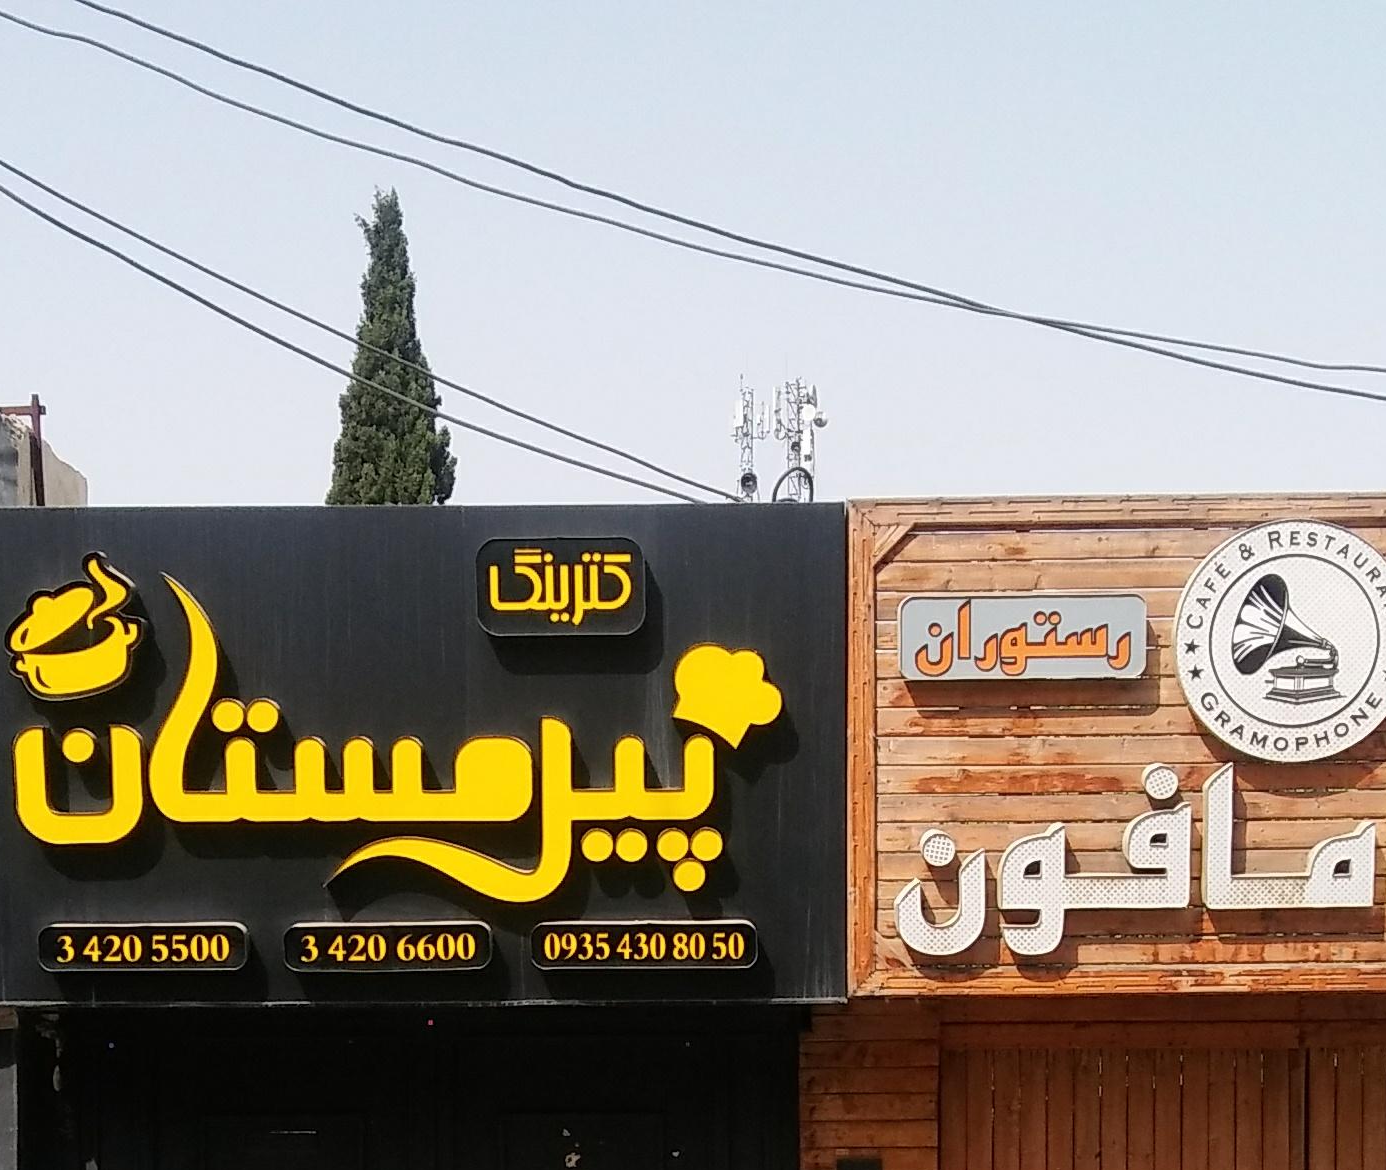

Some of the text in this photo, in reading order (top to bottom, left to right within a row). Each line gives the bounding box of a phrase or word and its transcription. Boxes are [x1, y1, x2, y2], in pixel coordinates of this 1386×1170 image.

[1238, 543, 1255, 561] &
[489, 548, 632, 626] کترینگ
[915, 599, 1131, 677] رستوران
[1200, 692, 1383, 752] GRAMOPHONE
[55, 934, 230, 962] 3 420 5500
[300, 933, 476, 962] 3 420 6600
